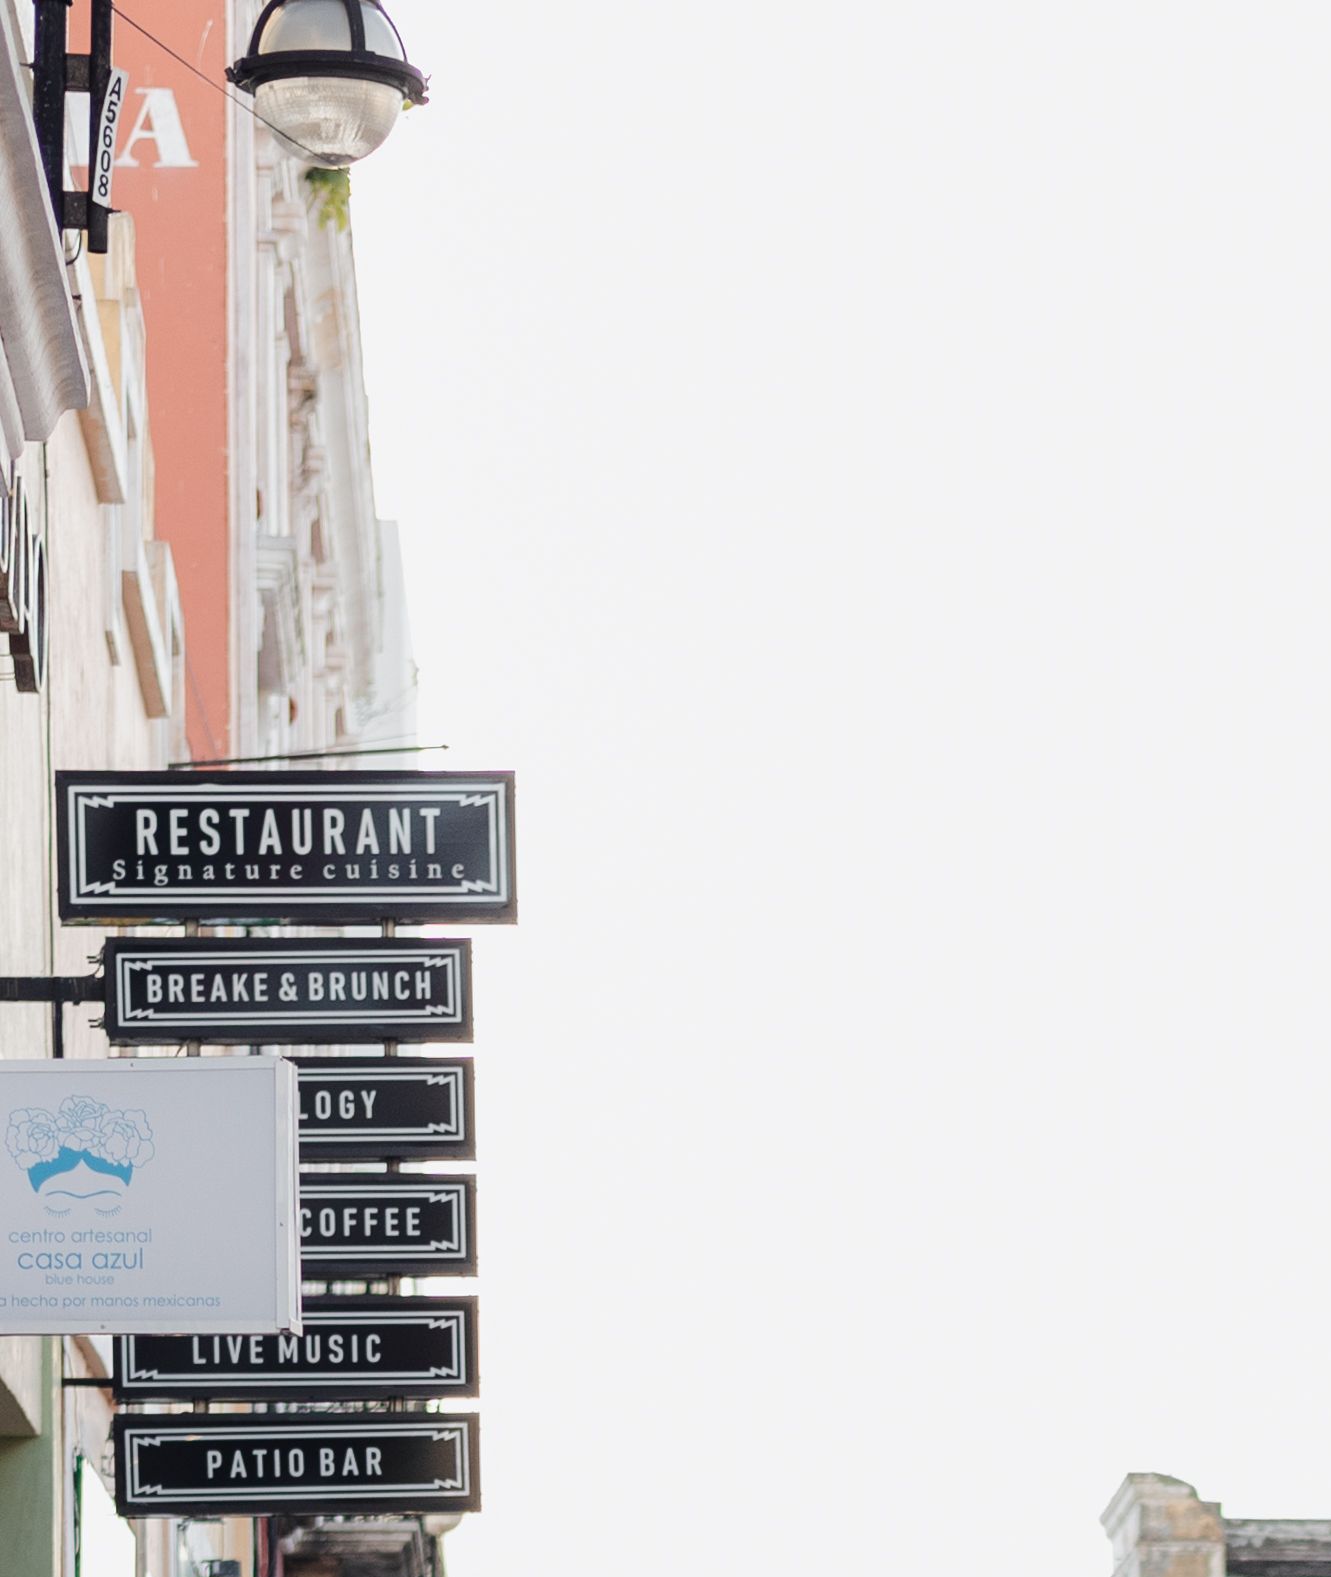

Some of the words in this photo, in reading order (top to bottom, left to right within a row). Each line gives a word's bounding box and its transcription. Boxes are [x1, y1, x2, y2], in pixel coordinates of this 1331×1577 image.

[98, 77, 122, 197] A5608
[135, 807, 441, 856] RESTAURANT
[111, 859, 304, 886] Signature
[322, 859, 466, 880] cuisine
[146, 973, 269, 1003] BREAKE
[308, 970, 432, 1001] BRUNCH
[8, 1229, 66, 1245] centro
[71, 1228, 152, 1244] artesanal
[300, 1206, 422, 1238] COFFEE
[17, 1252, 82, 1270] casa
[92, 1247, 144, 1270] azul
[45, 1274, 73, 1286] blue
[77, 1273, 115, 1286] house
[11, 1294, 58, 1308] hecha
[62, 1297, 86, 1309] por
[91, 1297, 139, 1308] manos
[142, 1294, 221, 1308] mexicanas
[192, 1335, 265, 1364] LIVE
[278, 1334, 383, 1364] MUSIC
[206, 1448, 306, 1479] PATIO
[319, 1446, 383, 1477] BAR
